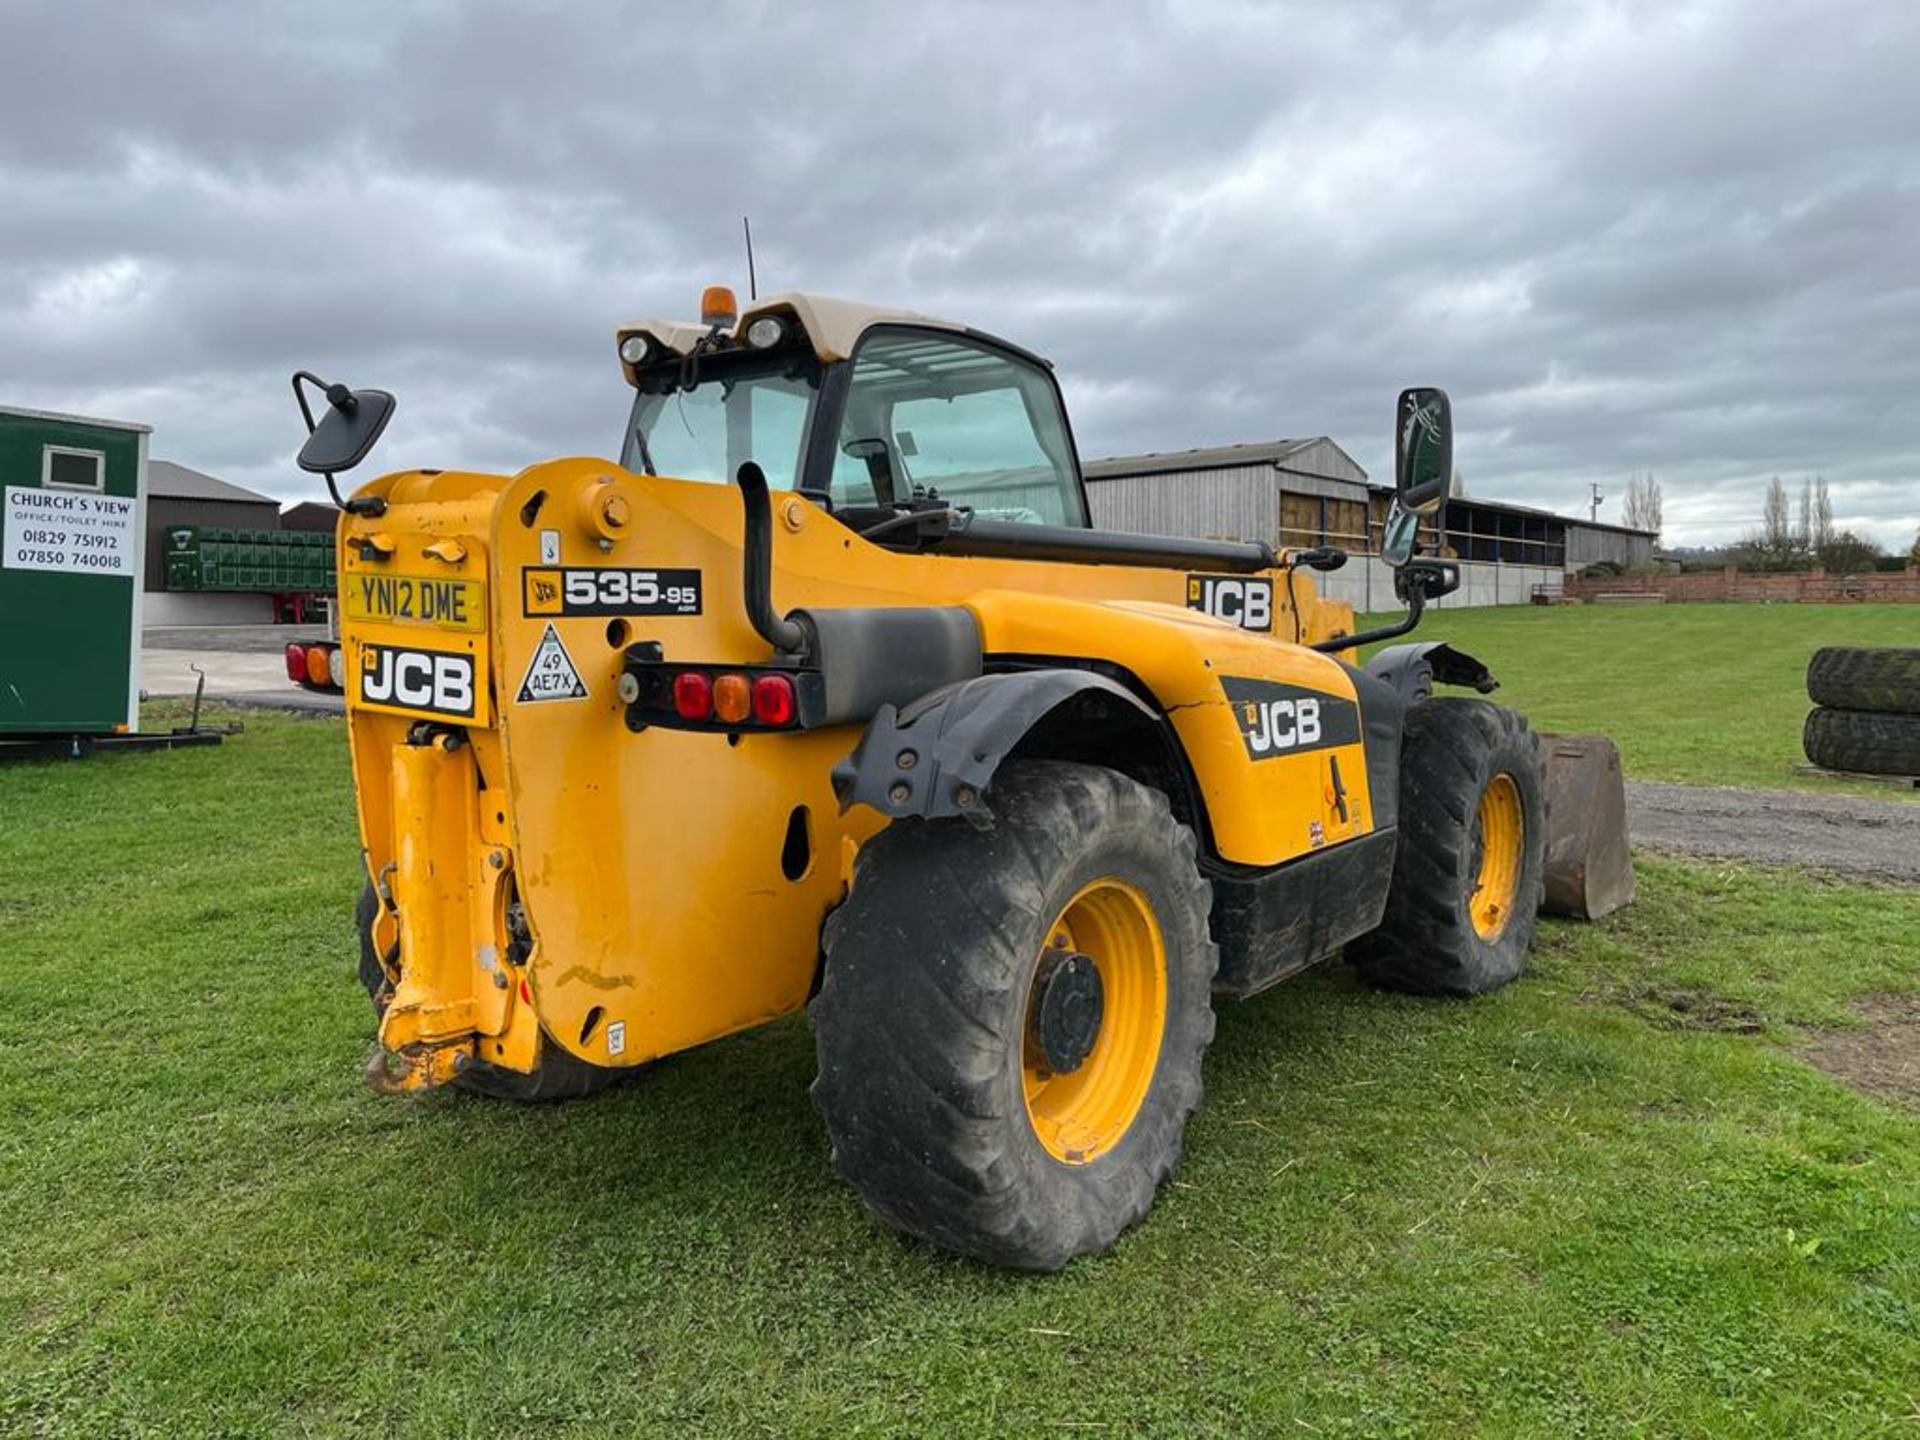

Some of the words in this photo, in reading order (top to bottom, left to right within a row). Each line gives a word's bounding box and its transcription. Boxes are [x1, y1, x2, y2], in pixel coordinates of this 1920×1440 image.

[11, 493, 88, 511] CHURCH'S
[94, 501, 130, 514] VIEW
[14, 511, 97, 526] OFFICE/TOILET
[102, 520, 126, 529] HIRE
[23, 529, 66, 544] 01829
[72, 534, 118, 549] 751912
[18, 549, 64, 564] 07850
[72, 553, 121, 568] 740018
[565, 571, 696, 604] 535-95
[362, 577, 413, 617] YN12
[420, 581, 467, 623] DME
[1188, 581, 1271, 628] JCB
[543, 653, 562, 670] 49
[363, 650, 473, 712] JCB
[533, 672, 571, 691] AE7X
[1250, 698, 1321, 752] JCB
